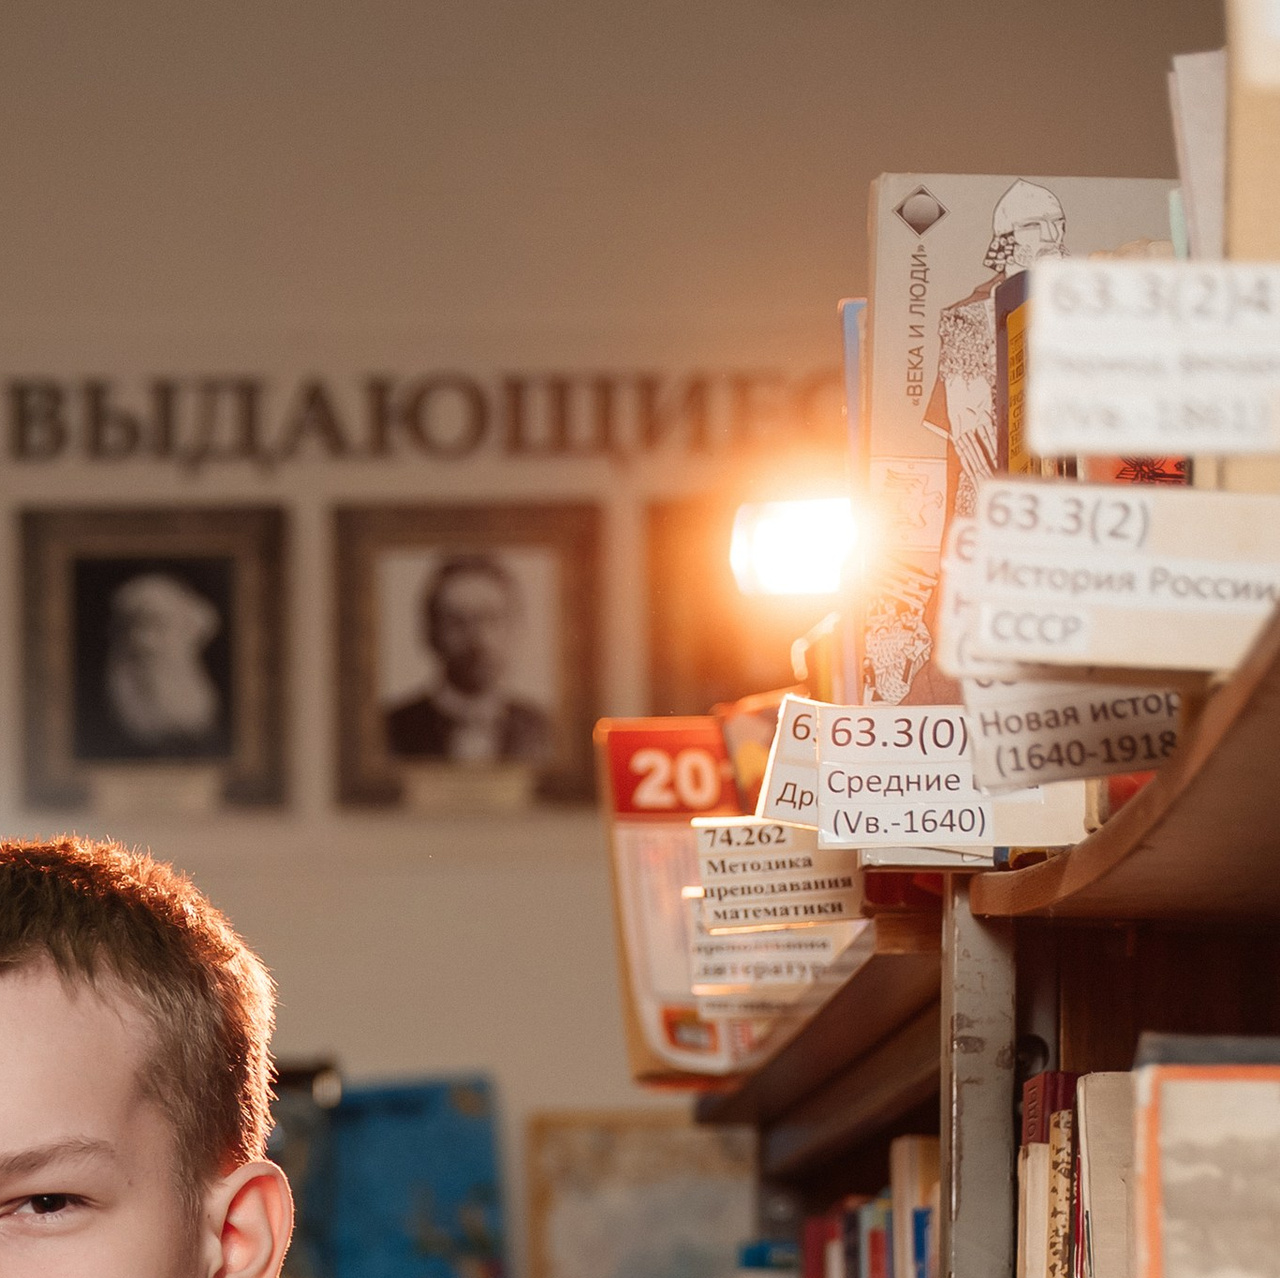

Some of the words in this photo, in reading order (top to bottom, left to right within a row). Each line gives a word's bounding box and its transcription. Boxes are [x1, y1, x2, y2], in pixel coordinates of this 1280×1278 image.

[910, 243, 931, 318] ЛЮДИ»
[909, 324, 924, 340] И
[907, 345, 924, 406] «ВЕКА
[987, 489, 1149, 547] 63.3(2)
[986, 558, 1138, 595] История
[1150, 566, 1278, 601] России
[991, 611, 1083, 644] СССР
[831, 716, 968, 755] 63.3(0)
[980, 704, 1082, 737] Новая
[631, 750, 719, 809] 20
[827, 769, 961, 798] Средние
[704, 826, 786, 848] 74.262
[832, 807, 986, 837] (Vв.-1640)
[707, 855, 813, 876] Методика
[704, 876, 853, 901] преподавания
[713, 900, 844, 921] математики
